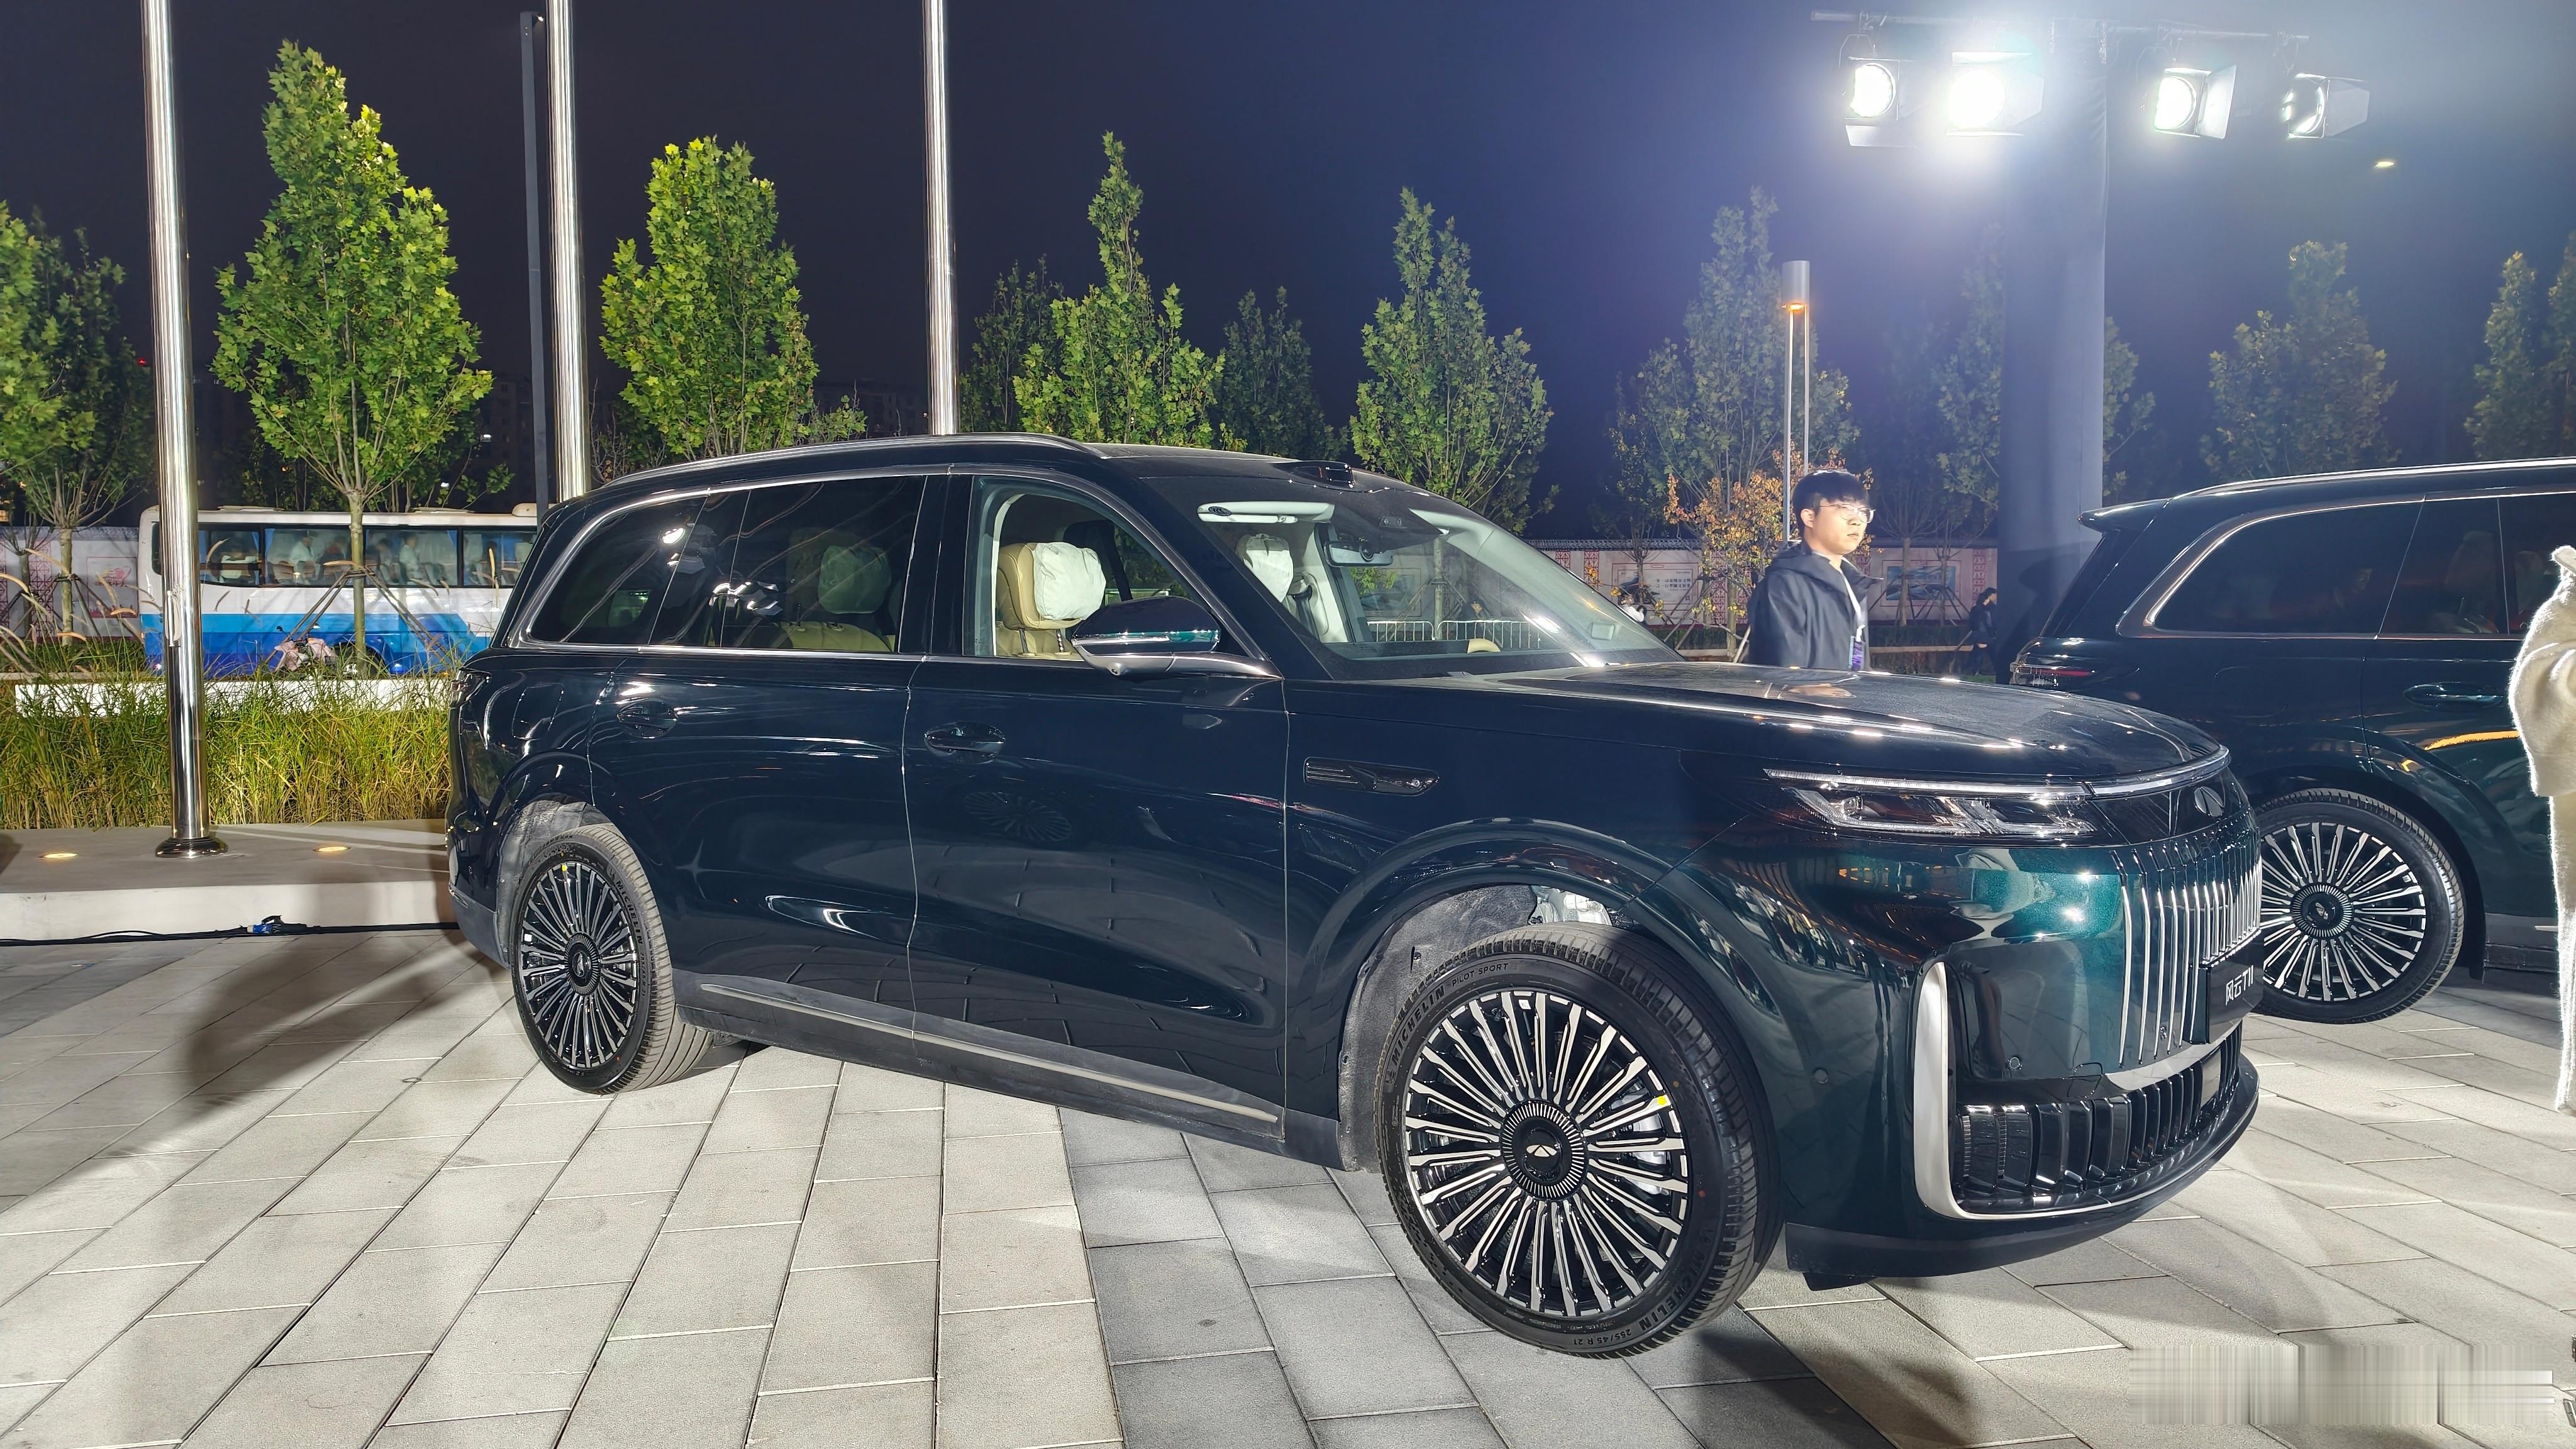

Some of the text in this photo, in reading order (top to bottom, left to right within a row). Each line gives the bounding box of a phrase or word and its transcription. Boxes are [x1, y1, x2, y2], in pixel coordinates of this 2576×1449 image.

[616, 880, 643, 944] MICHELIN
[1392, 963, 1509, 1065] MICHELIN PILOT SPORT
[1597, 1328, 1632, 1345] 255/45
